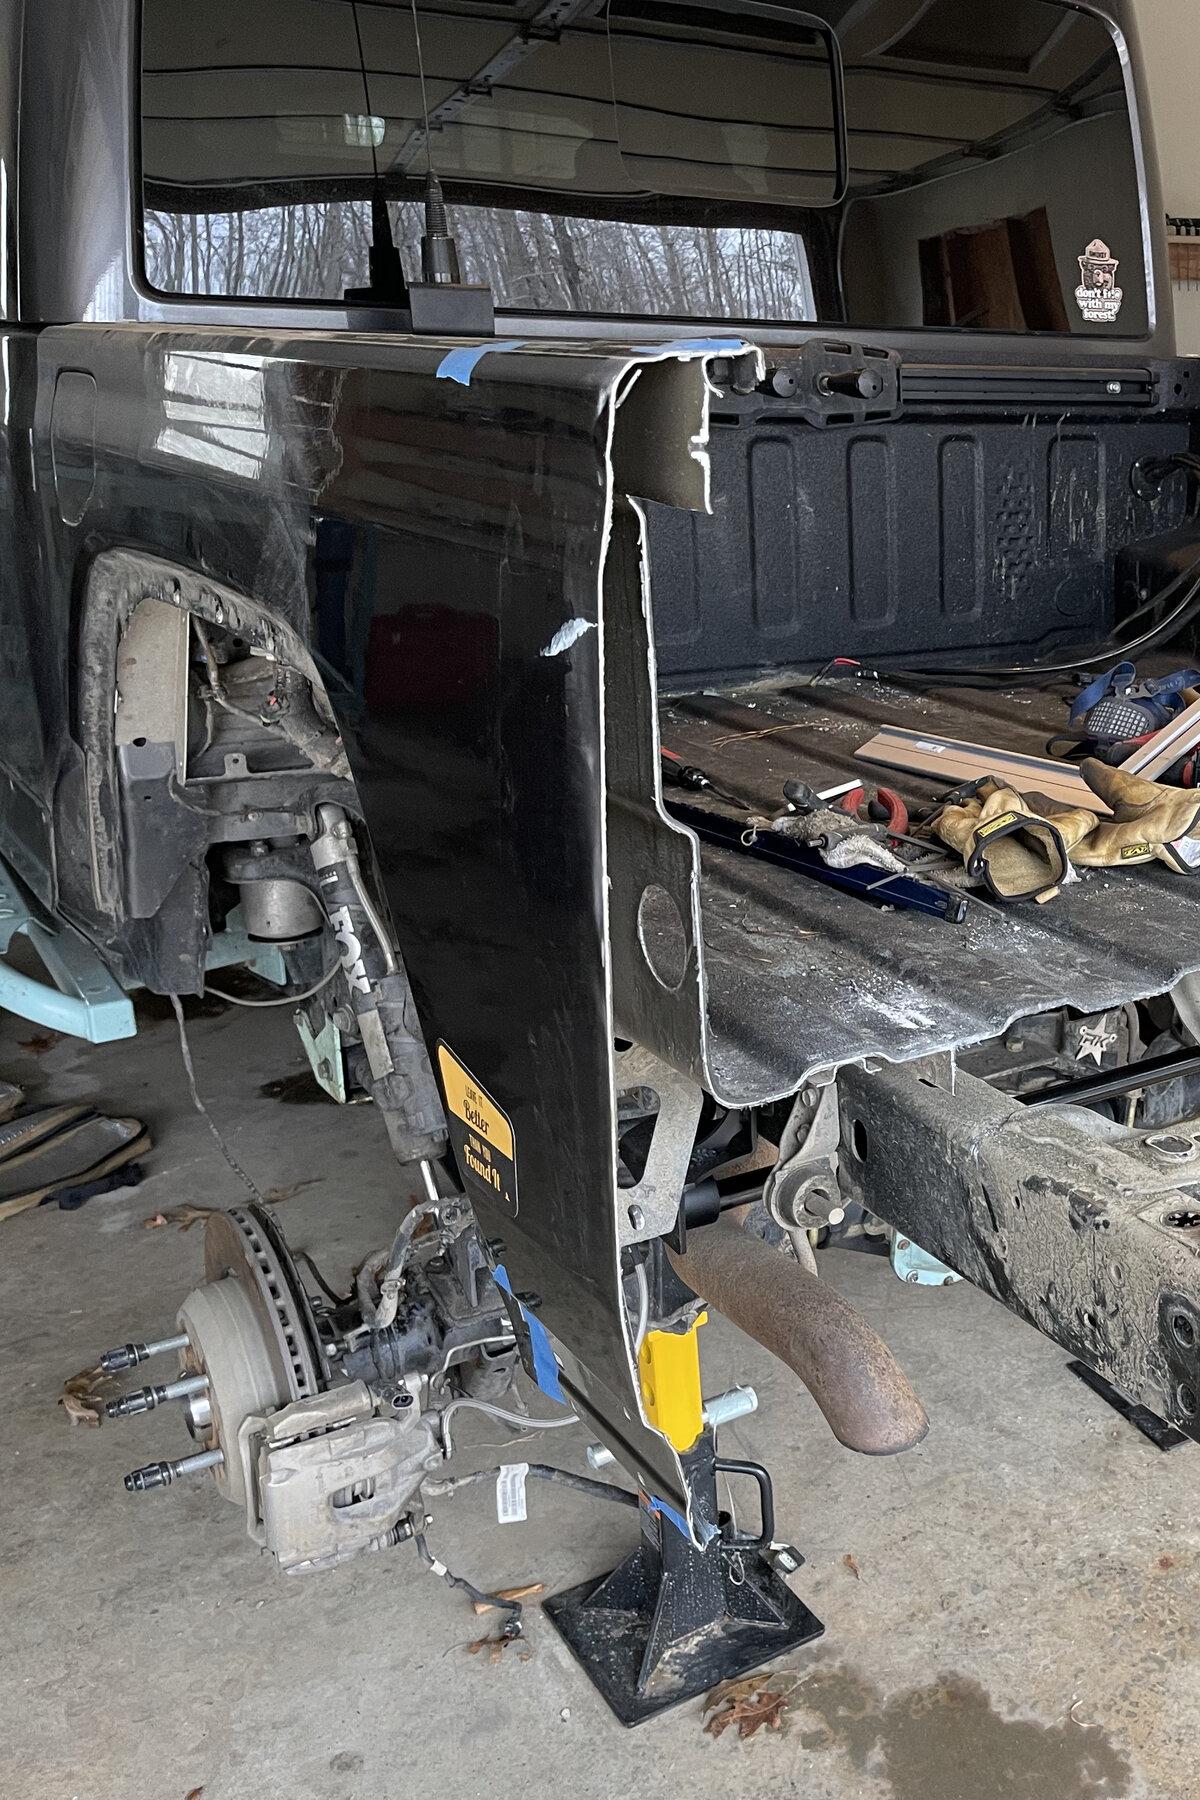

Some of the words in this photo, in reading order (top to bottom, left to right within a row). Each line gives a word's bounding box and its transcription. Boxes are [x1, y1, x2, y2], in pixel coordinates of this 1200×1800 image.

[1077, 287, 1102, 298] don't
[1078, 298, 1103, 309] with
[1104, 301, 1120, 312] my
[329, 905, 371, 994] FOX
[463, 1099, 489, 1135] Better
[463, 1144, 492, 1184] Found
